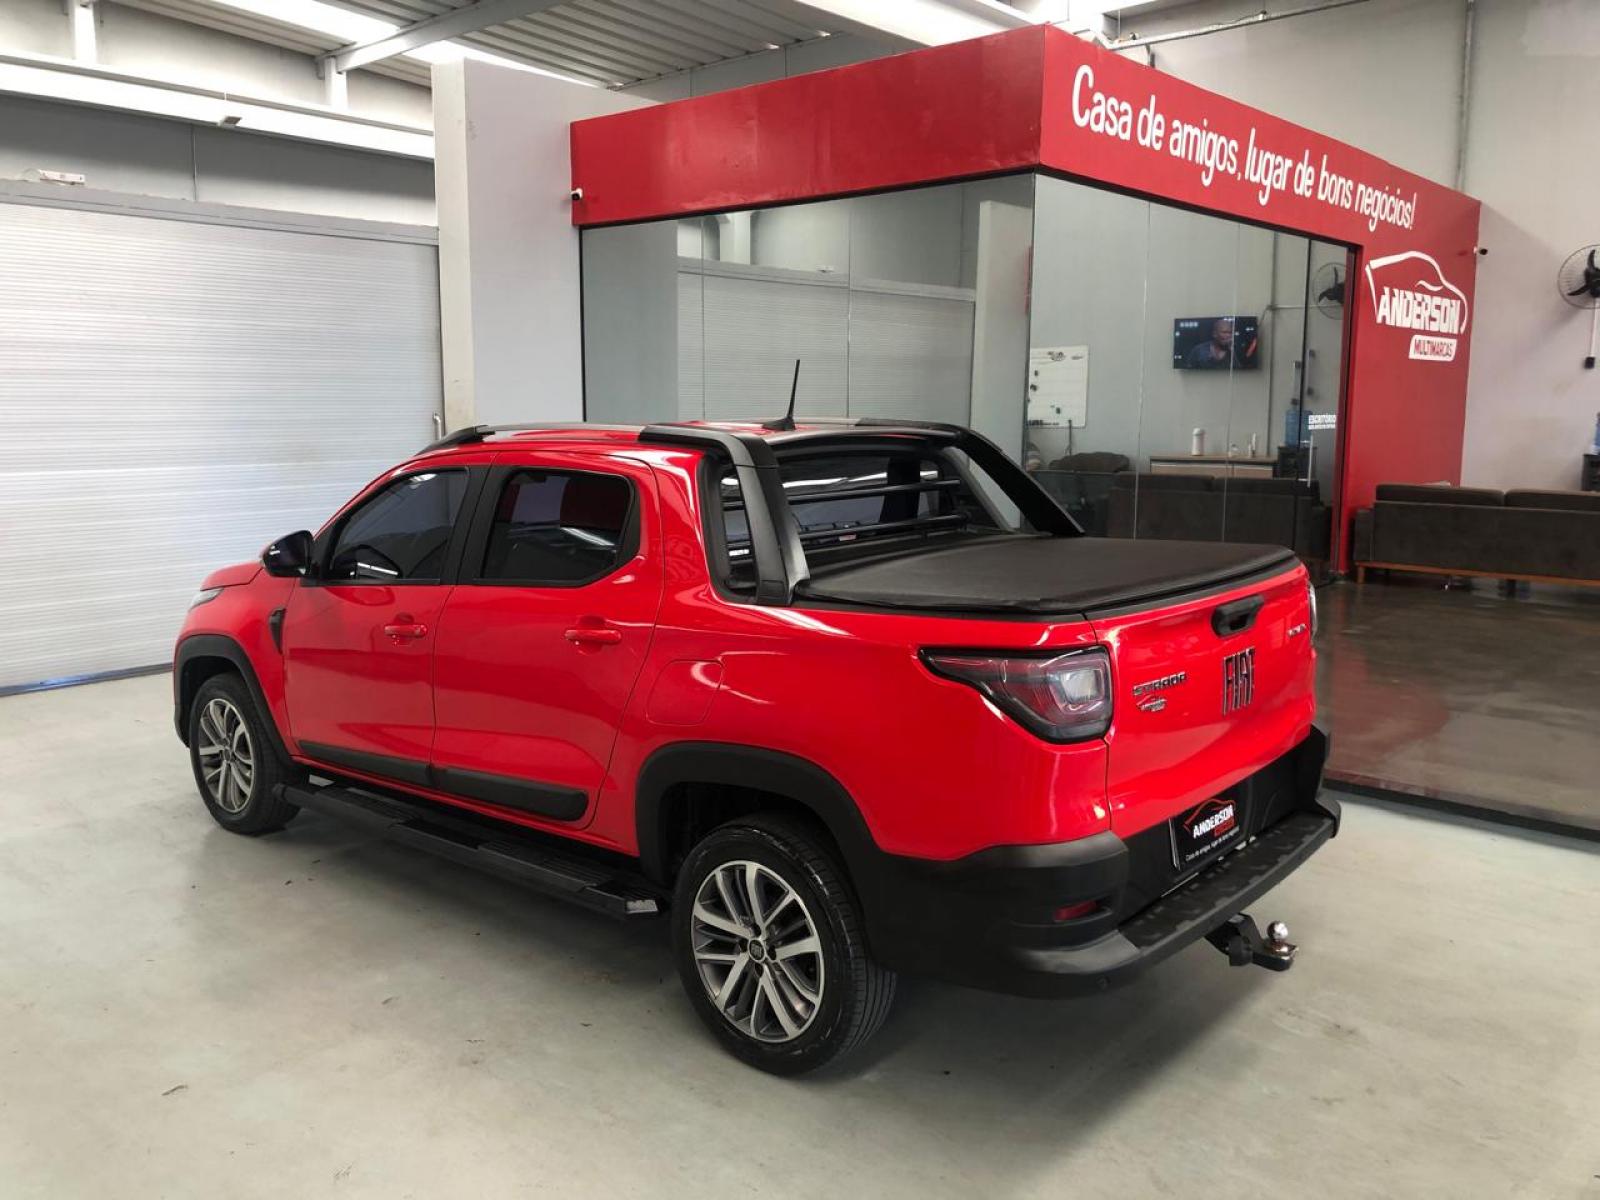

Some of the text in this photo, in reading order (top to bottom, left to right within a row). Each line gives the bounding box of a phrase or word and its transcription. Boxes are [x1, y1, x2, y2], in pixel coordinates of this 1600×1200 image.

[1072, 64, 1417, 232] Casa de amigos, lugar de bons negócios!
[1376, 286, 1460, 334] ANDERSON
[1414, 338, 1453, 357] MULTIMARCAS
[1223, 645, 1255, 716] FIAT
[1193, 804, 1234, 839] ANDERSON
